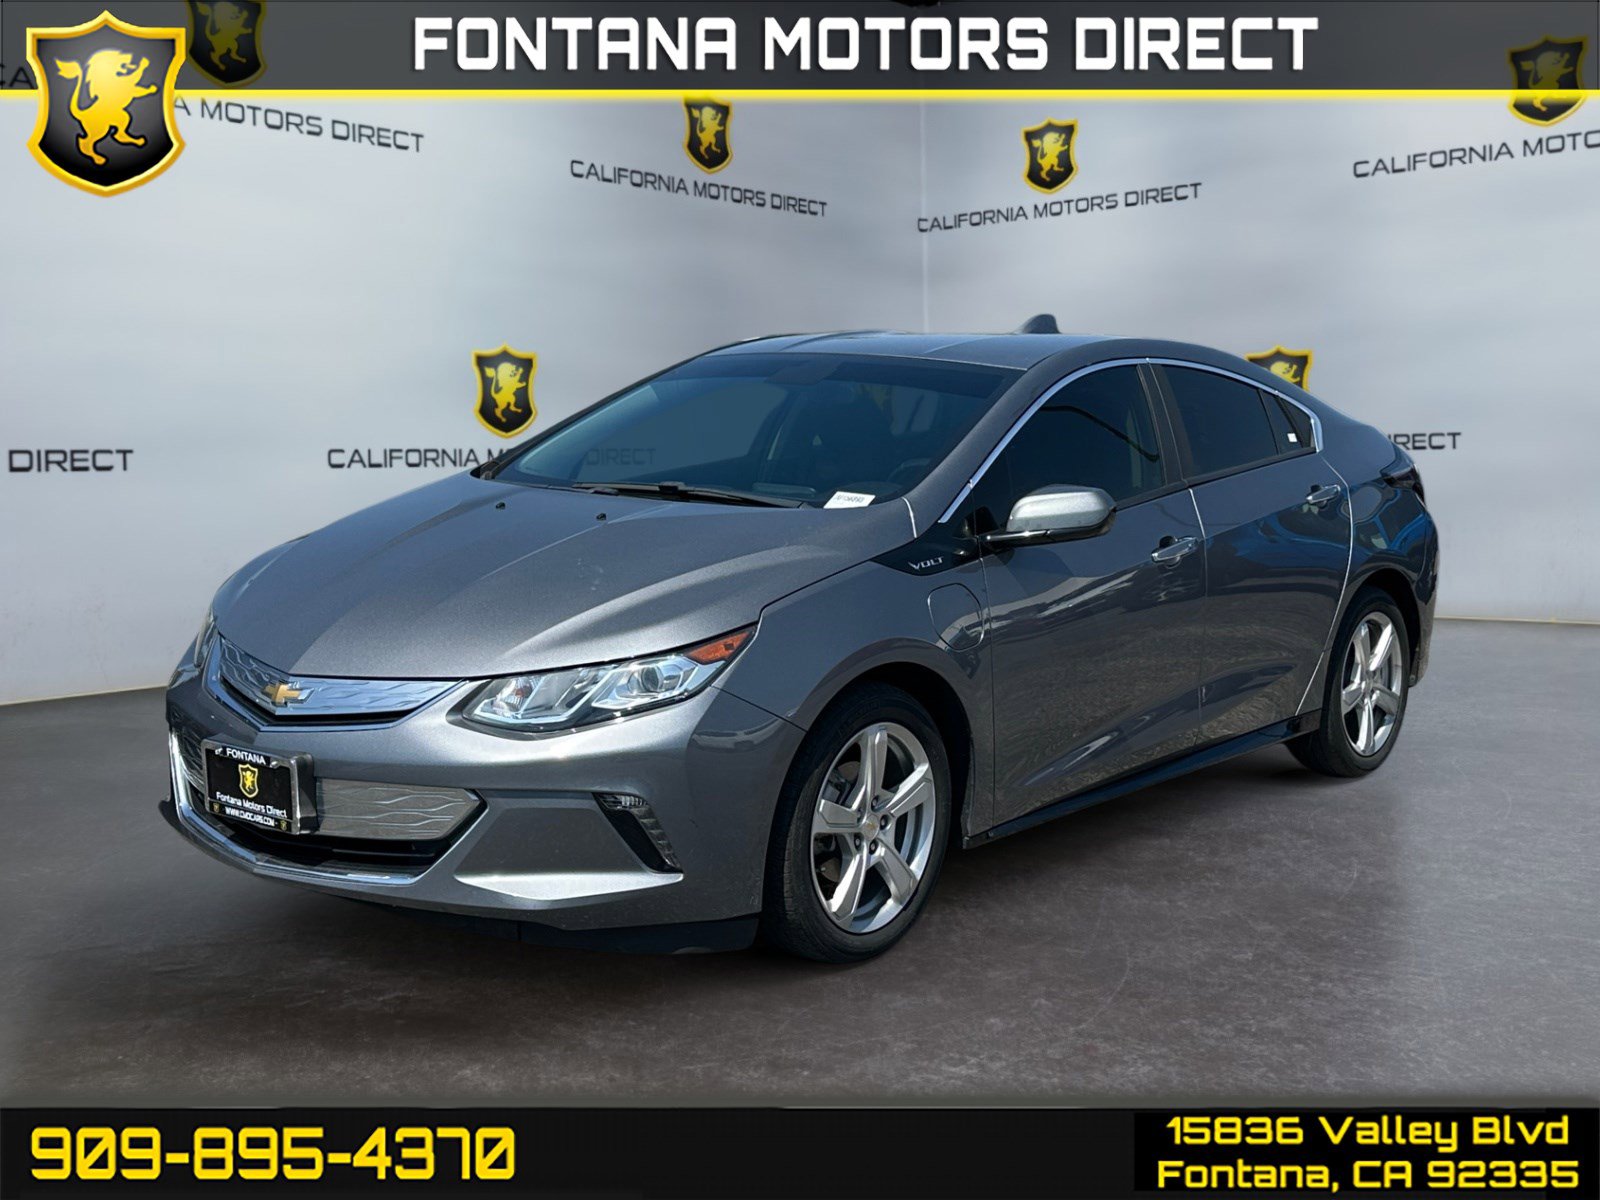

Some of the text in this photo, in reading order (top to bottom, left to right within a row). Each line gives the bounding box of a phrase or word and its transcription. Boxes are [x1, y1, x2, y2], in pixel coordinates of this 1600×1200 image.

[202, 99, 322, 136] MOTORS
[331, 120, 423, 152] DIRECT
[1353, 142, 1514, 178] CALIFORNIA
[570, 160, 827, 217] CALIFORNIA MOTORS DIRECT
[917, 182, 1202, 233] CALIFORNIA MOTORS DIRECT
[8, 449, 133, 472] DIRECT
[327, 448, 480, 468] CALIFORNIA
[908, 556, 945, 570] VOLT
[226, 748, 266, 765] FONTANA
[216, 791, 287, 818] Fontana Motors Direct
